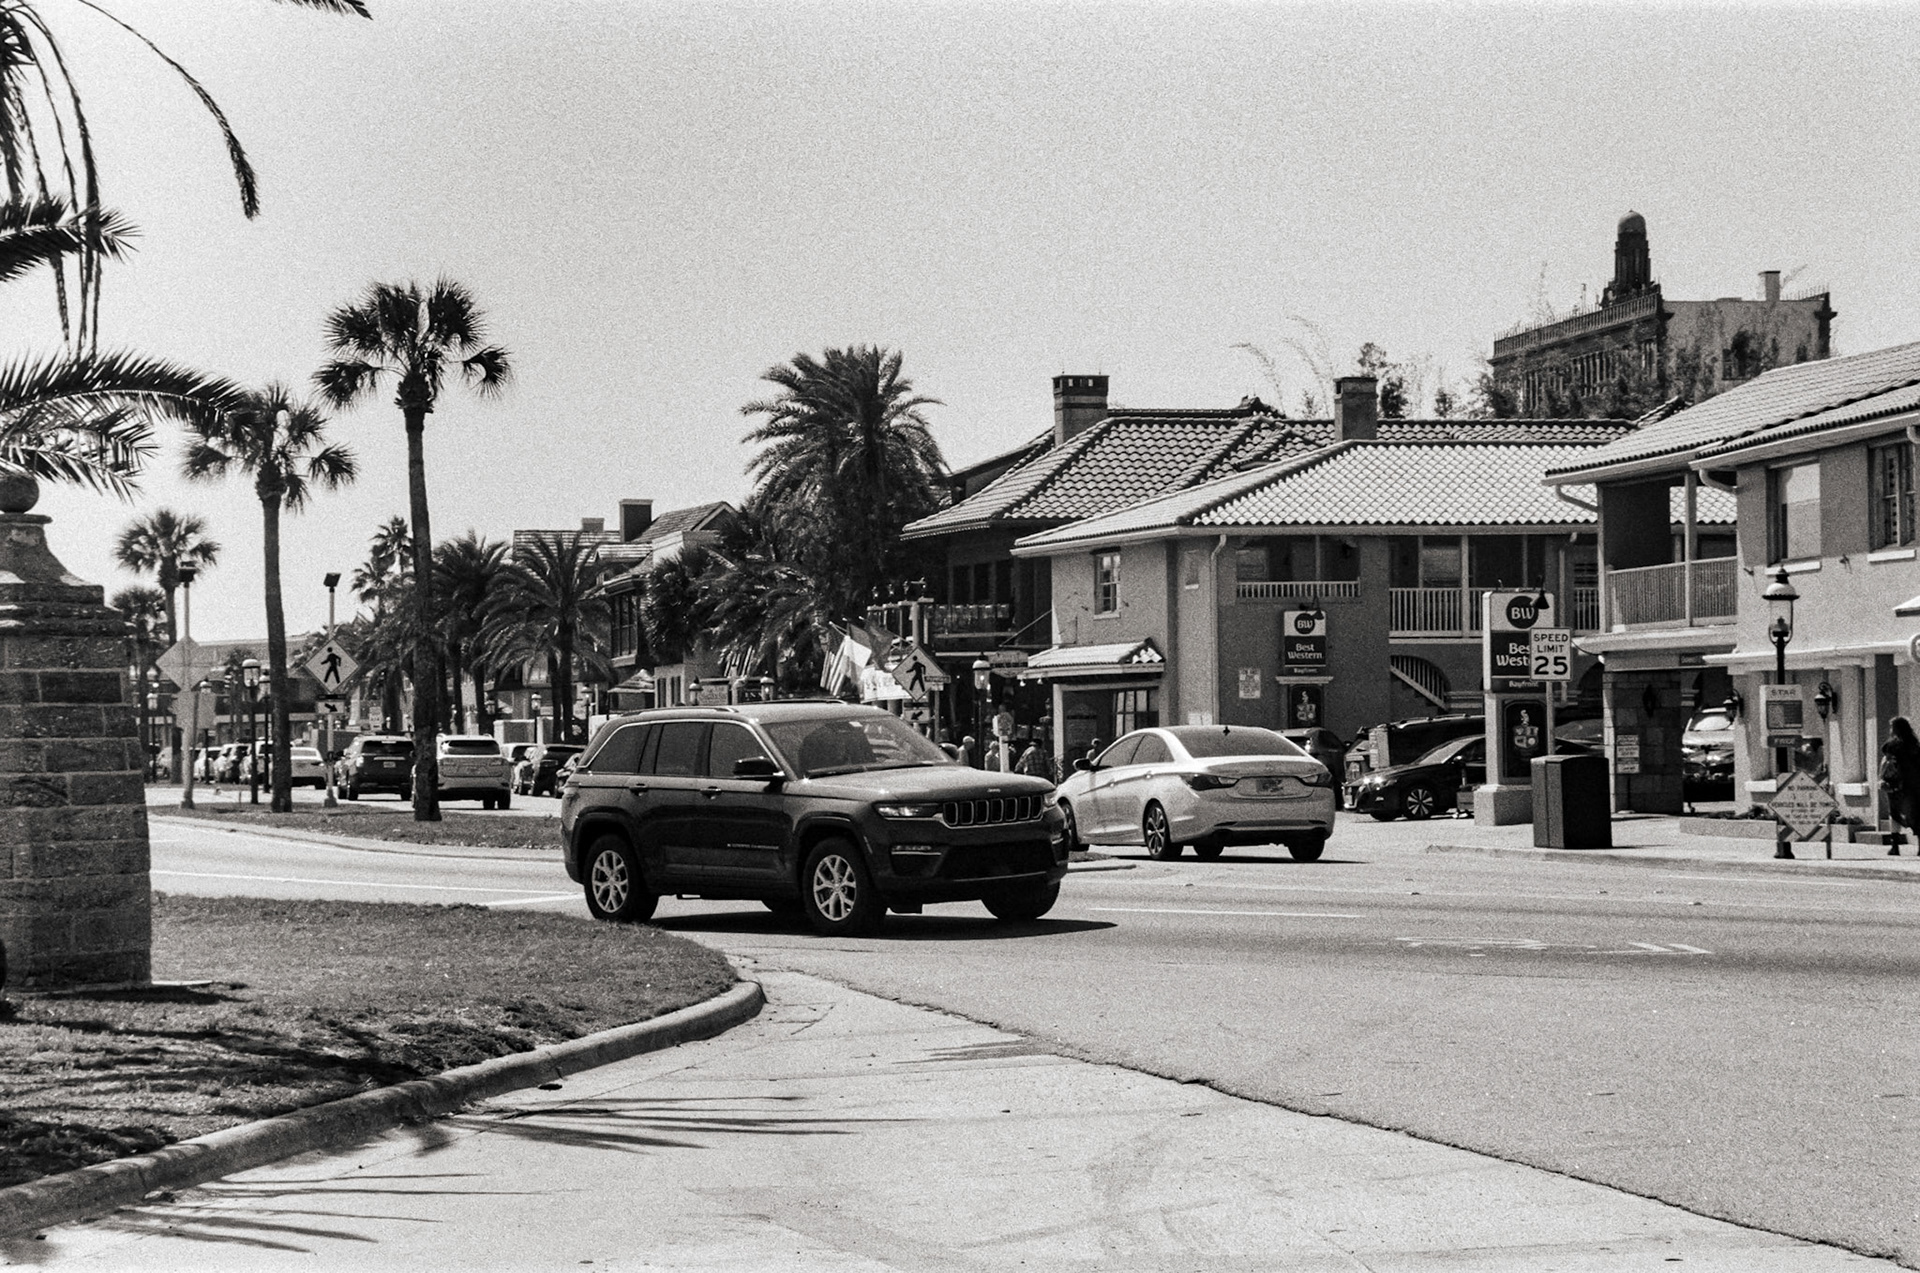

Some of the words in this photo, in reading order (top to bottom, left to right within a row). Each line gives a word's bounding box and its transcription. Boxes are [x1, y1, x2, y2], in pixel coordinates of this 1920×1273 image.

[1511, 607, 1535, 620] BW
[1533, 633, 1569, 642] SPEED
[1296, 643, 1315, 651] Best
[1509, 643, 1530, 654] Bes
[1537, 644, 1565, 653] LIMIT
[1287, 651, 1323, 659] Western
[1496, 654, 1530, 666] West
[1534, 655, 1569, 675] 25
